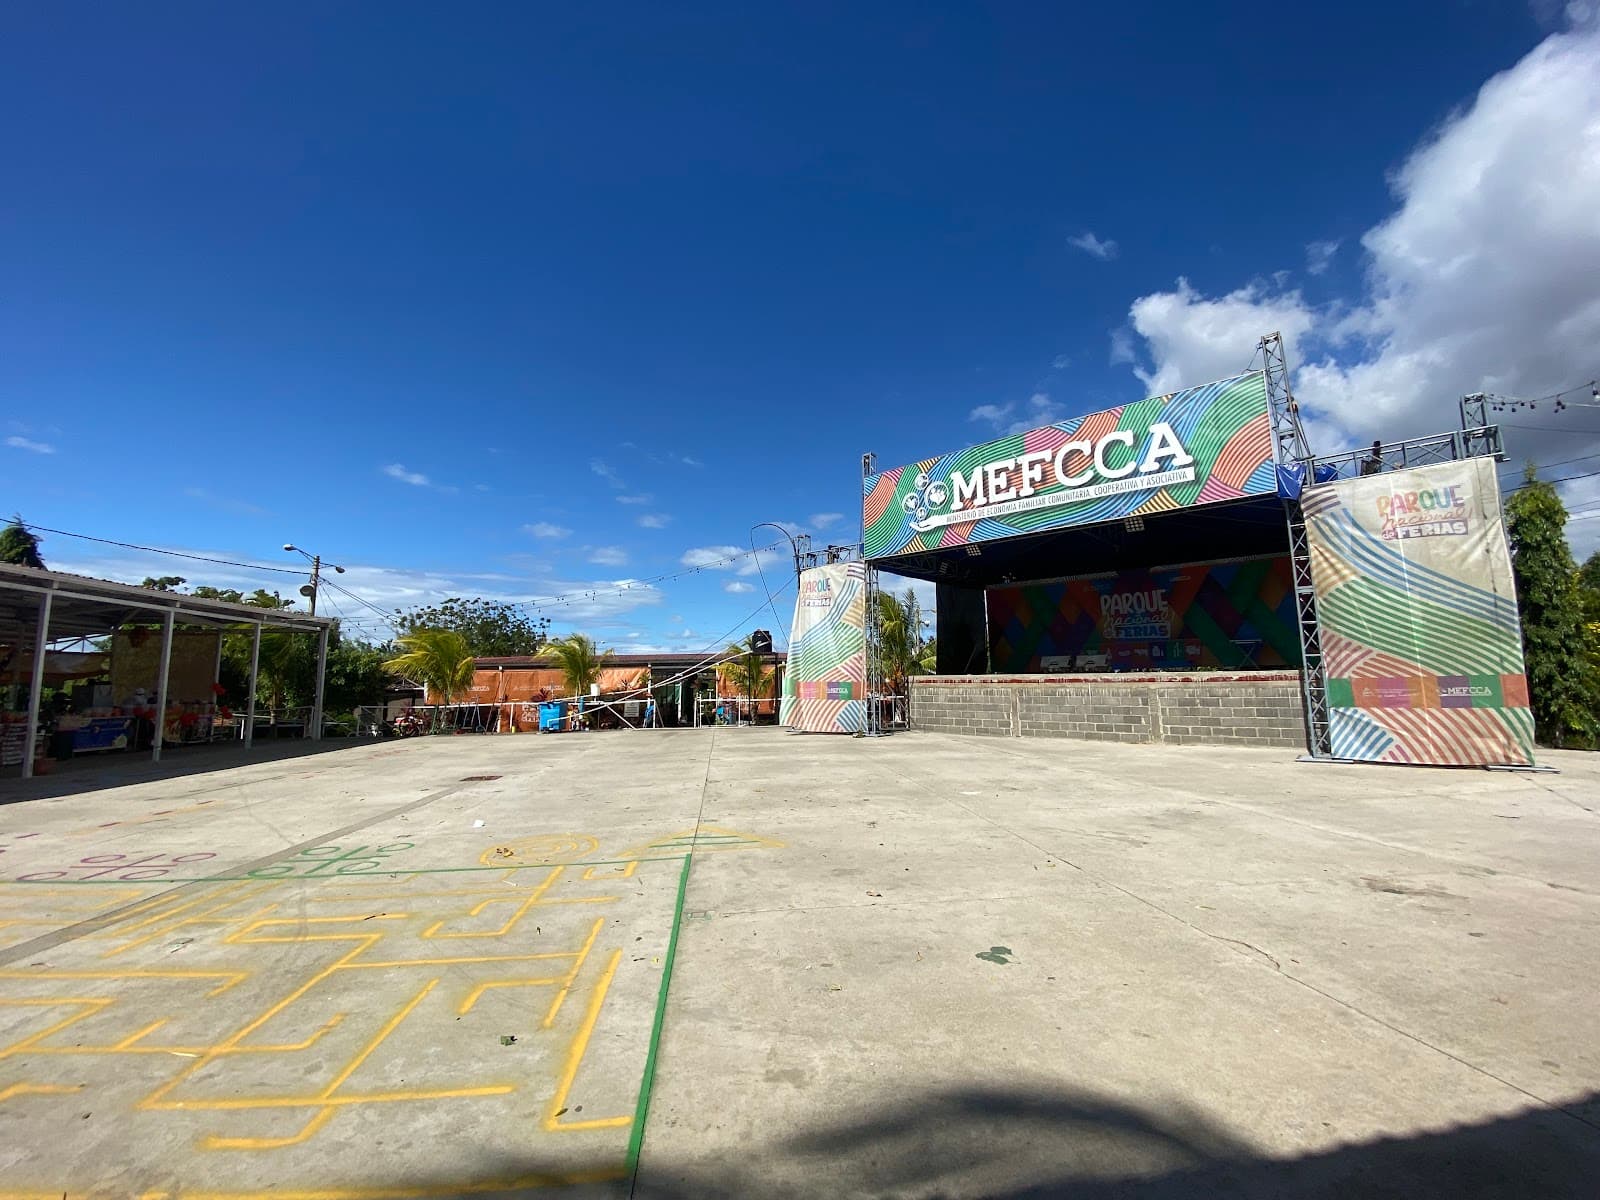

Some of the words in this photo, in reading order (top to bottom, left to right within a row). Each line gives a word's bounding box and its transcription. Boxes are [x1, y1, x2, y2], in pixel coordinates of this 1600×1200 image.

[949, 421, 1194, 511] MEFCCA
[946, 511, 977, 523] MINISTERIO
[978, 509, 986, 518] DE
[1018, 499, 1046, 511] FAMILIAR
[1093, 480, 1139, 496] COOPERATIVA
[1139, 477, 1145, 485] Y
[1146, 471, 1188, 487] ASOCIATIVA
[1376, 485, 1466, 517] PARQUE
[1382, 530, 1396, 540] de
[1396, 521, 1467, 539] FERIAS
[1100, 589, 1169, 616] PARQUE
[1115, 622, 1167, 636] FERIAS
[1447, 686, 1492, 695] MEFCCA
